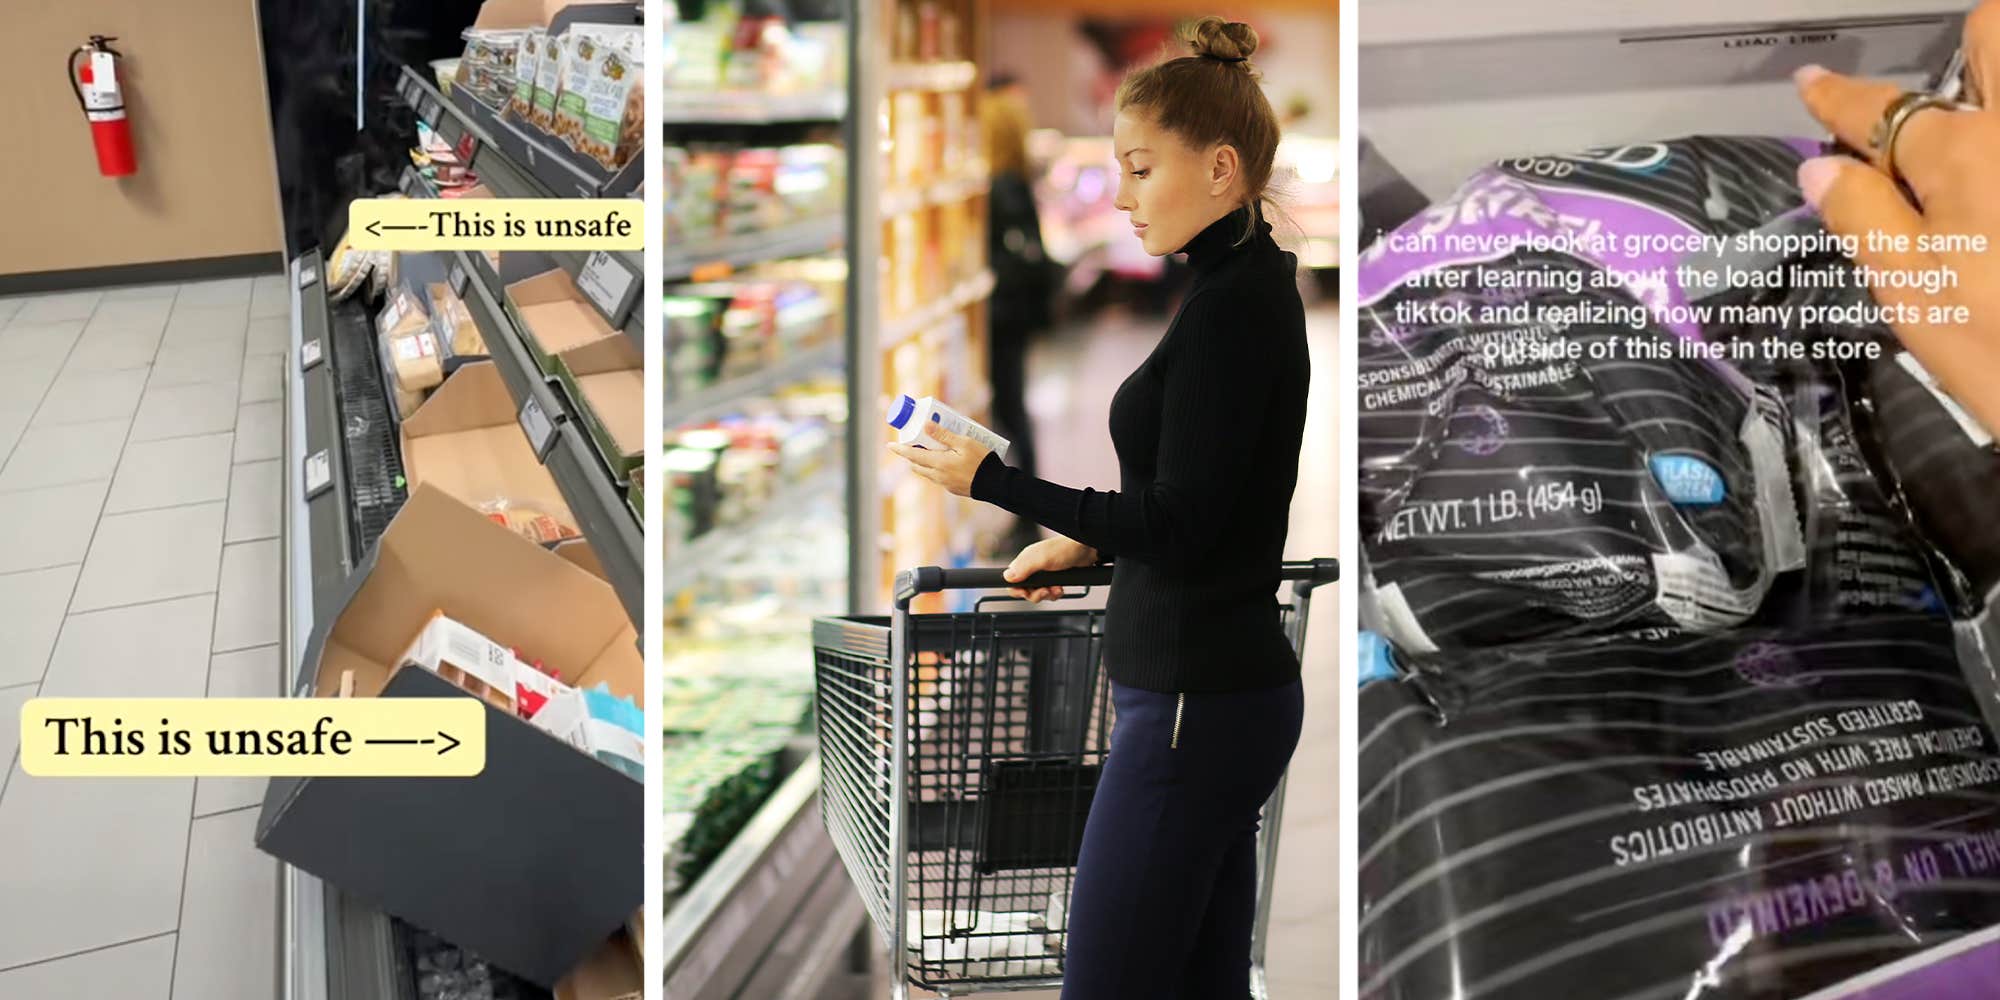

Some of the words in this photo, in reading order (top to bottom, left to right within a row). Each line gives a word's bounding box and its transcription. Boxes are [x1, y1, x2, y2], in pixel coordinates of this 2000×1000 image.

[1723, 37, 1779, 48] LOAD
[1377, 507, 1419, 545] NET
[1419, 498, 1468, 535] WT.
[1472, 498, 1483, 526] 1
[1489, 489, 1524, 523] LB.
[1526, 481, 1577, 520] (454
[1837, 698, 1923, 735] CERTIFIED
[1696, 715, 1837, 771] SUSTAINABLE
[1815, 741, 1869, 772] WITH
[1869, 735, 1913, 764] FREE
[1779, 753, 1815, 780] NO
[1865, 770, 1922, 805] RAISED
[1924, 757, 2000, 800] SPONSIBLY
[1633, 770, 1778, 812] PHOSPHATES
[1769, 783, 1864, 827] WITHOUT
[1608, 806, 1764, 867] ANTIBIOTICS
[1943, 830, 2000, 876] HELL
[1706, 870, 1868, 946] DEVEIND
